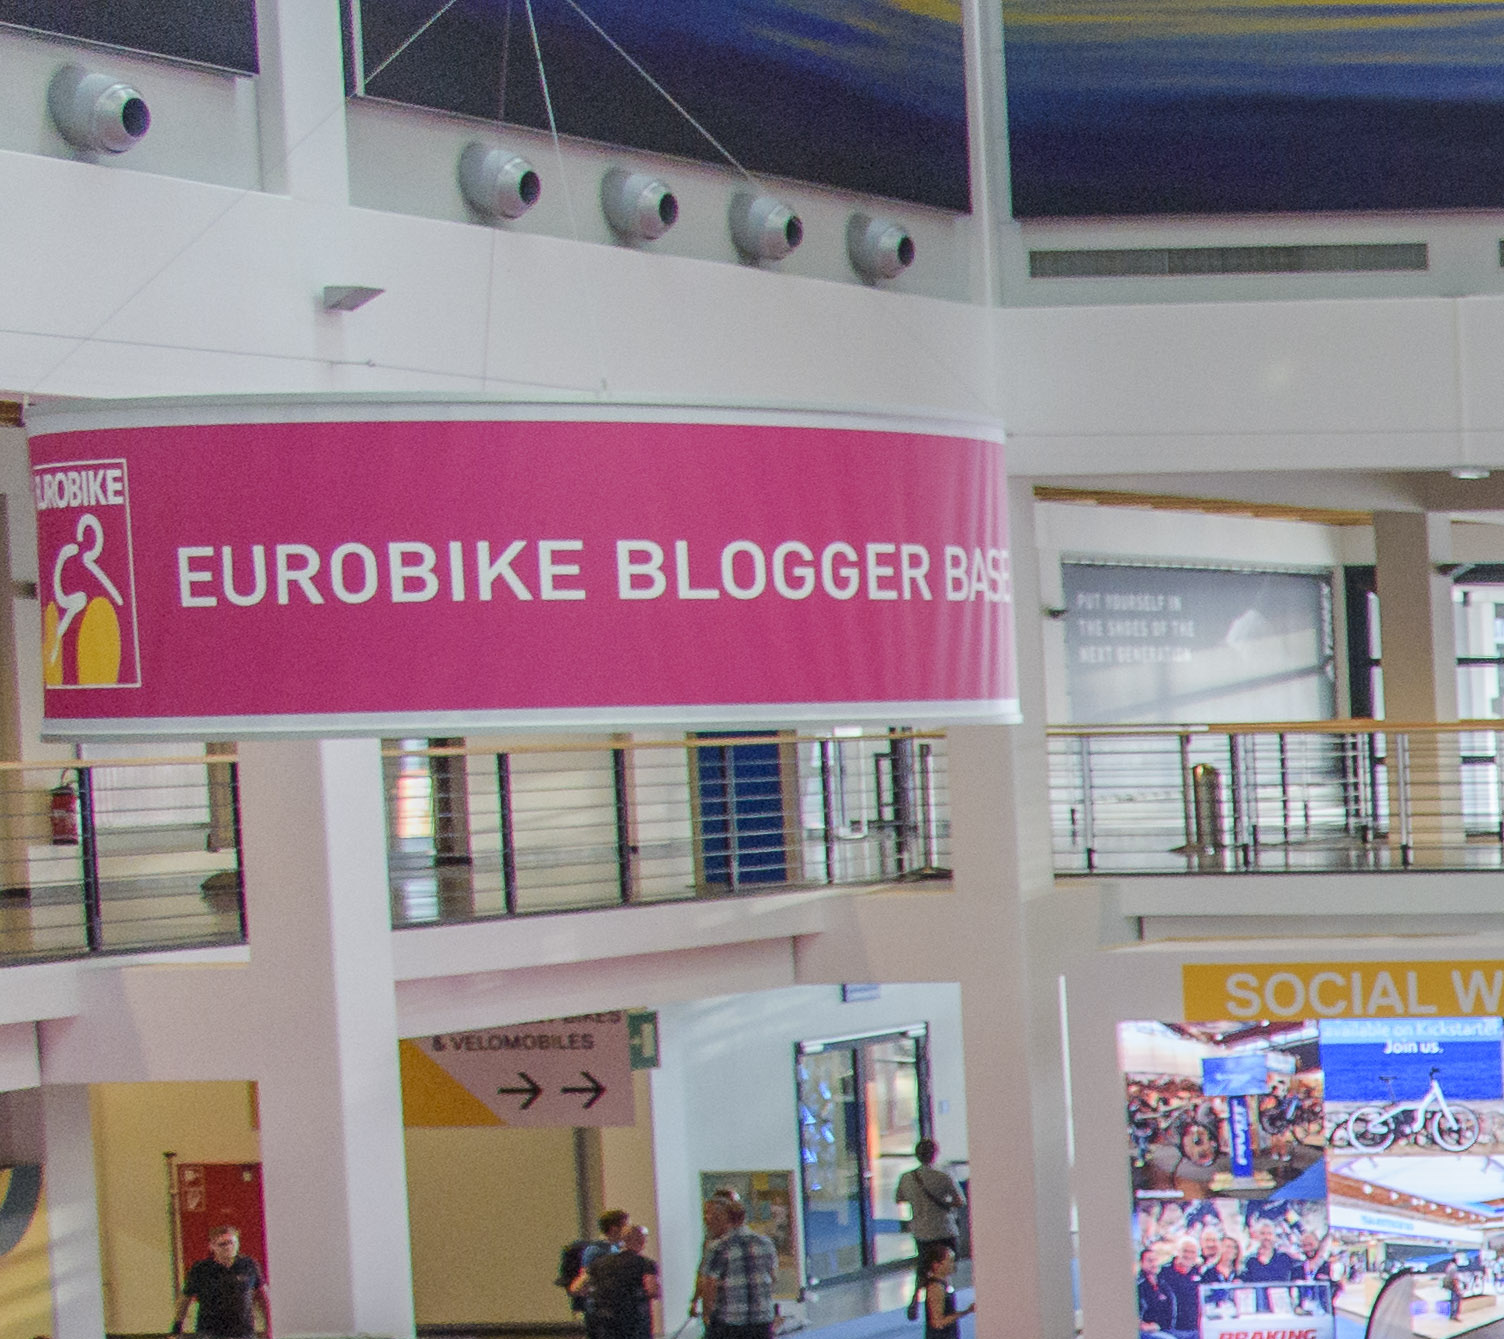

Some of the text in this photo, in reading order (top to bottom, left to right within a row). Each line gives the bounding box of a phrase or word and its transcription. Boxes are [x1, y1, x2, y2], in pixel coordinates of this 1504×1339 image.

[177, 539, 1012, 607] EUROBIKE BLOGGER BASE
[1078, 593, 1101, 611] PUT
[1079, 620, 1103, 638] THE
[1225, 971, 1438, 1017] SOCIAL
[431, 1033, 595, 1052] & VELOMOBILES
[1383, 1039, 1416, 1054] Join
